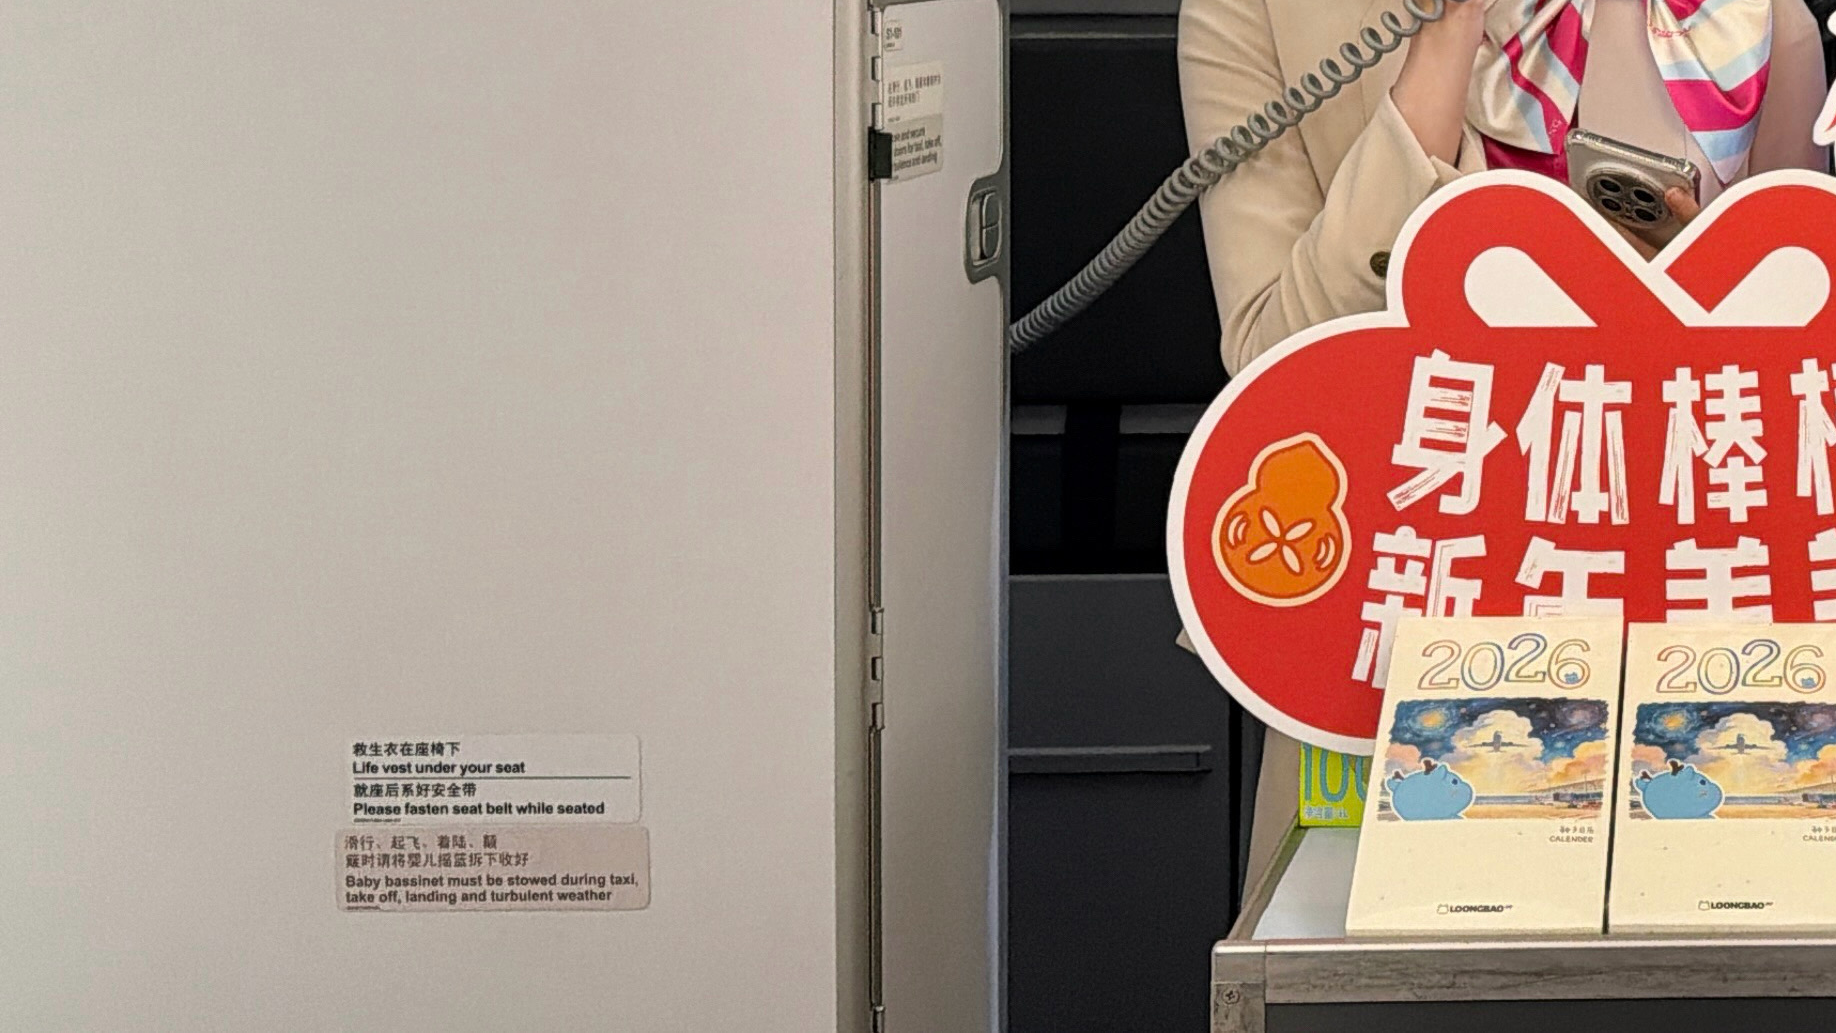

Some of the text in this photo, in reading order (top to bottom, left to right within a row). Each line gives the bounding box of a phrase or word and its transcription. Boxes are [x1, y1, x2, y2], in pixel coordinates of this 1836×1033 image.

[1417, 633, 1590, 691] 2026
[1656, 638, 1826, 694] 2026
[353, 741, 460, 757] 救生衣在座椅下
[353, 761, 525, 776] Life vest under your seat
[354, 782, 476, 798] 就座后系好安全带
[354, 802, 604, 815] Please fasten seat belt while seated
[345, 872, 639, 890] Baby bassinet must be stowed during taxi,
[346, 889, 612, 905] take off, landing and turbulent weather
[1450, 905, 1504, 913] LOONGBAO
